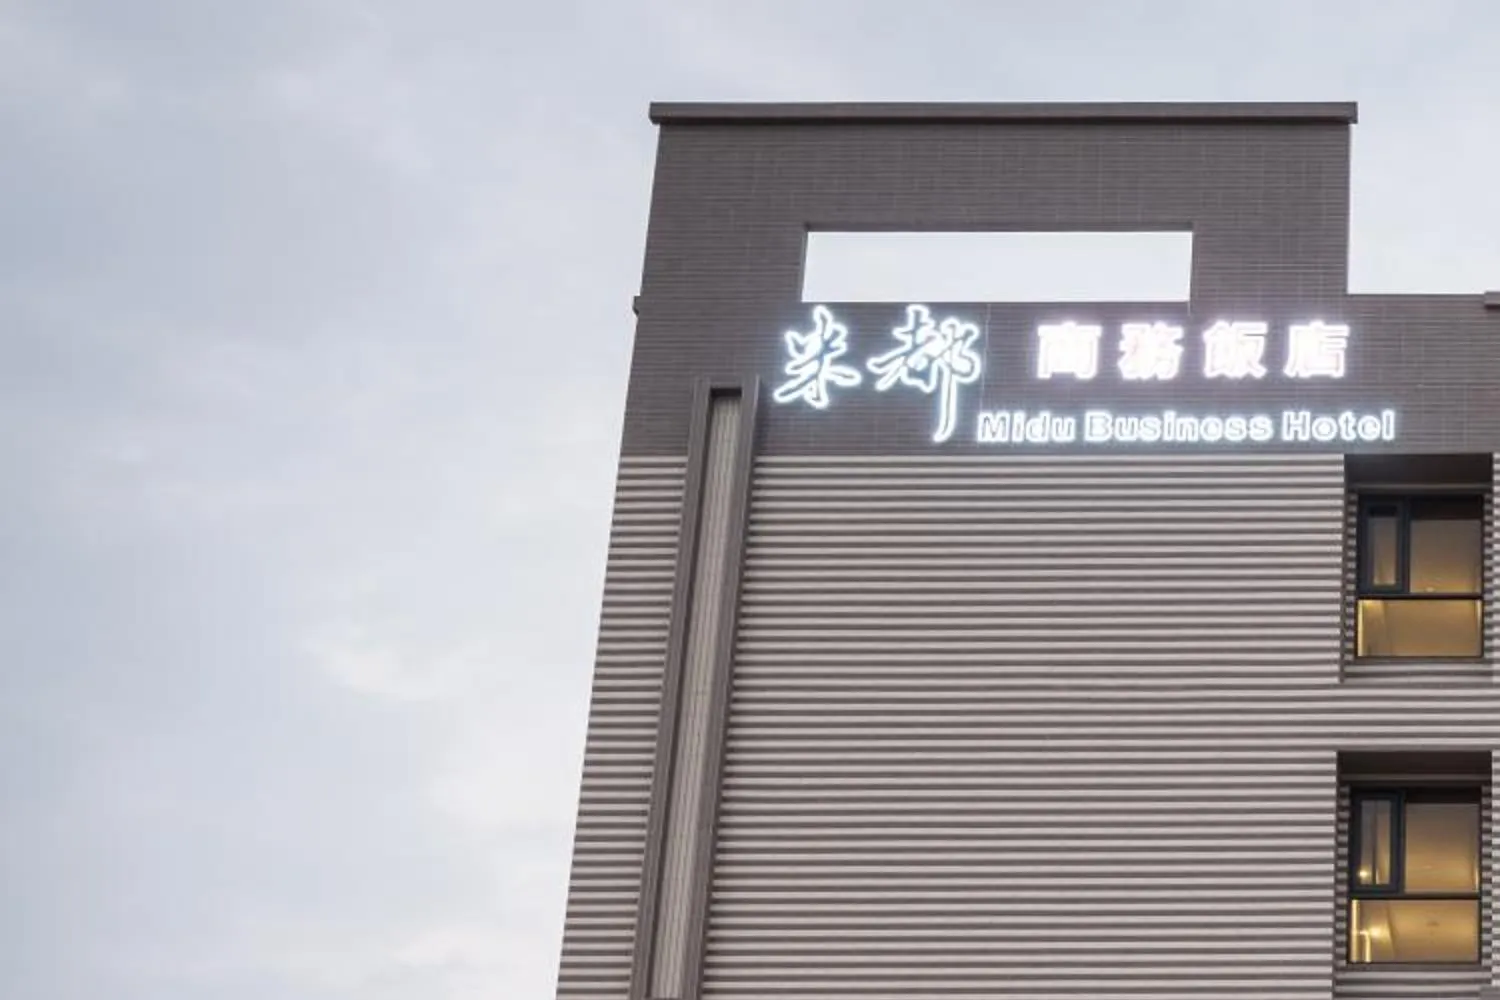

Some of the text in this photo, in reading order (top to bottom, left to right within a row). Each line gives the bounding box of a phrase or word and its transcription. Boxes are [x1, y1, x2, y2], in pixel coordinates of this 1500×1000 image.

[1037, 321, 1350, 380] 商務飯店
[977, 410, 1394, 442] Midu Business Hotel
